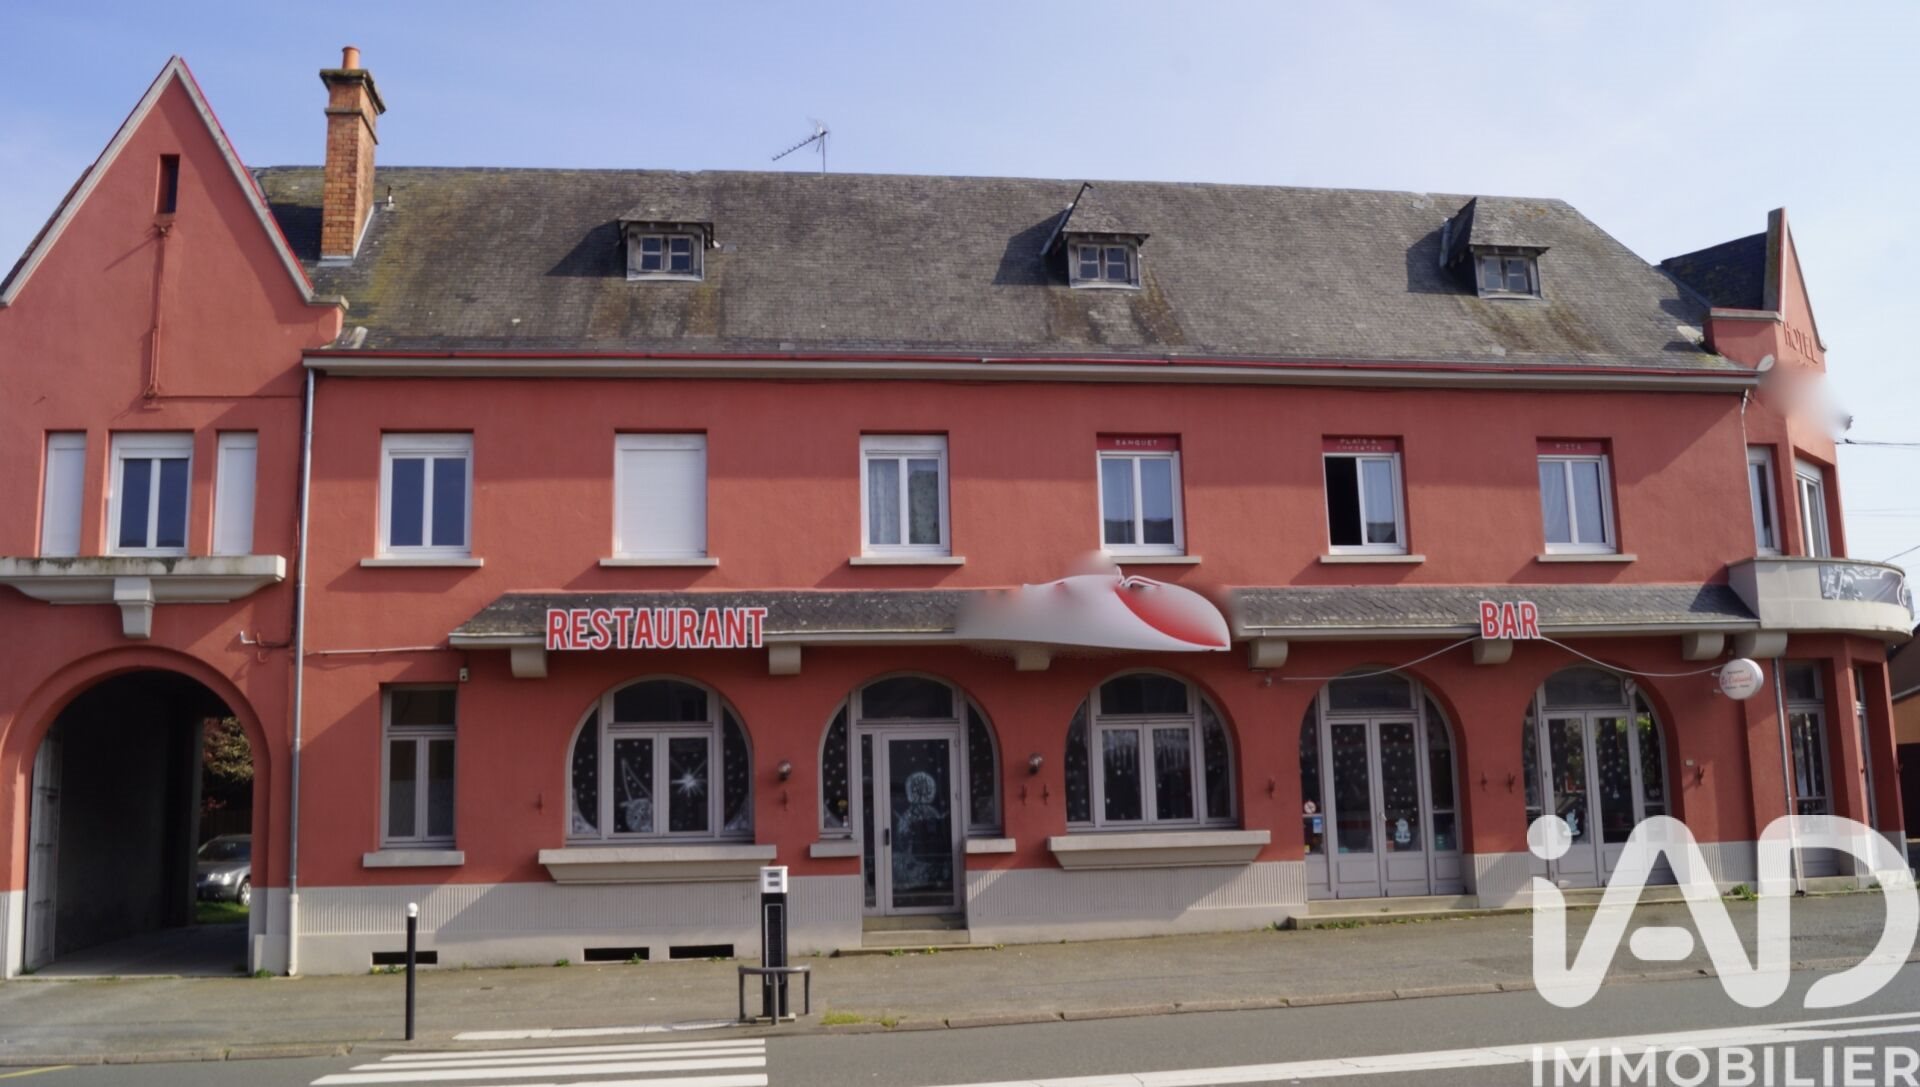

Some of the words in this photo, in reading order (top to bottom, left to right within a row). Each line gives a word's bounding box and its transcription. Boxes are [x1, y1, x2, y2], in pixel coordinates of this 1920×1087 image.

[1783, 320, 1818, 364] HOTEL
[546, 607, 768, 650] RESTAURANT
[1480, 601, 1540, 639] BAR
